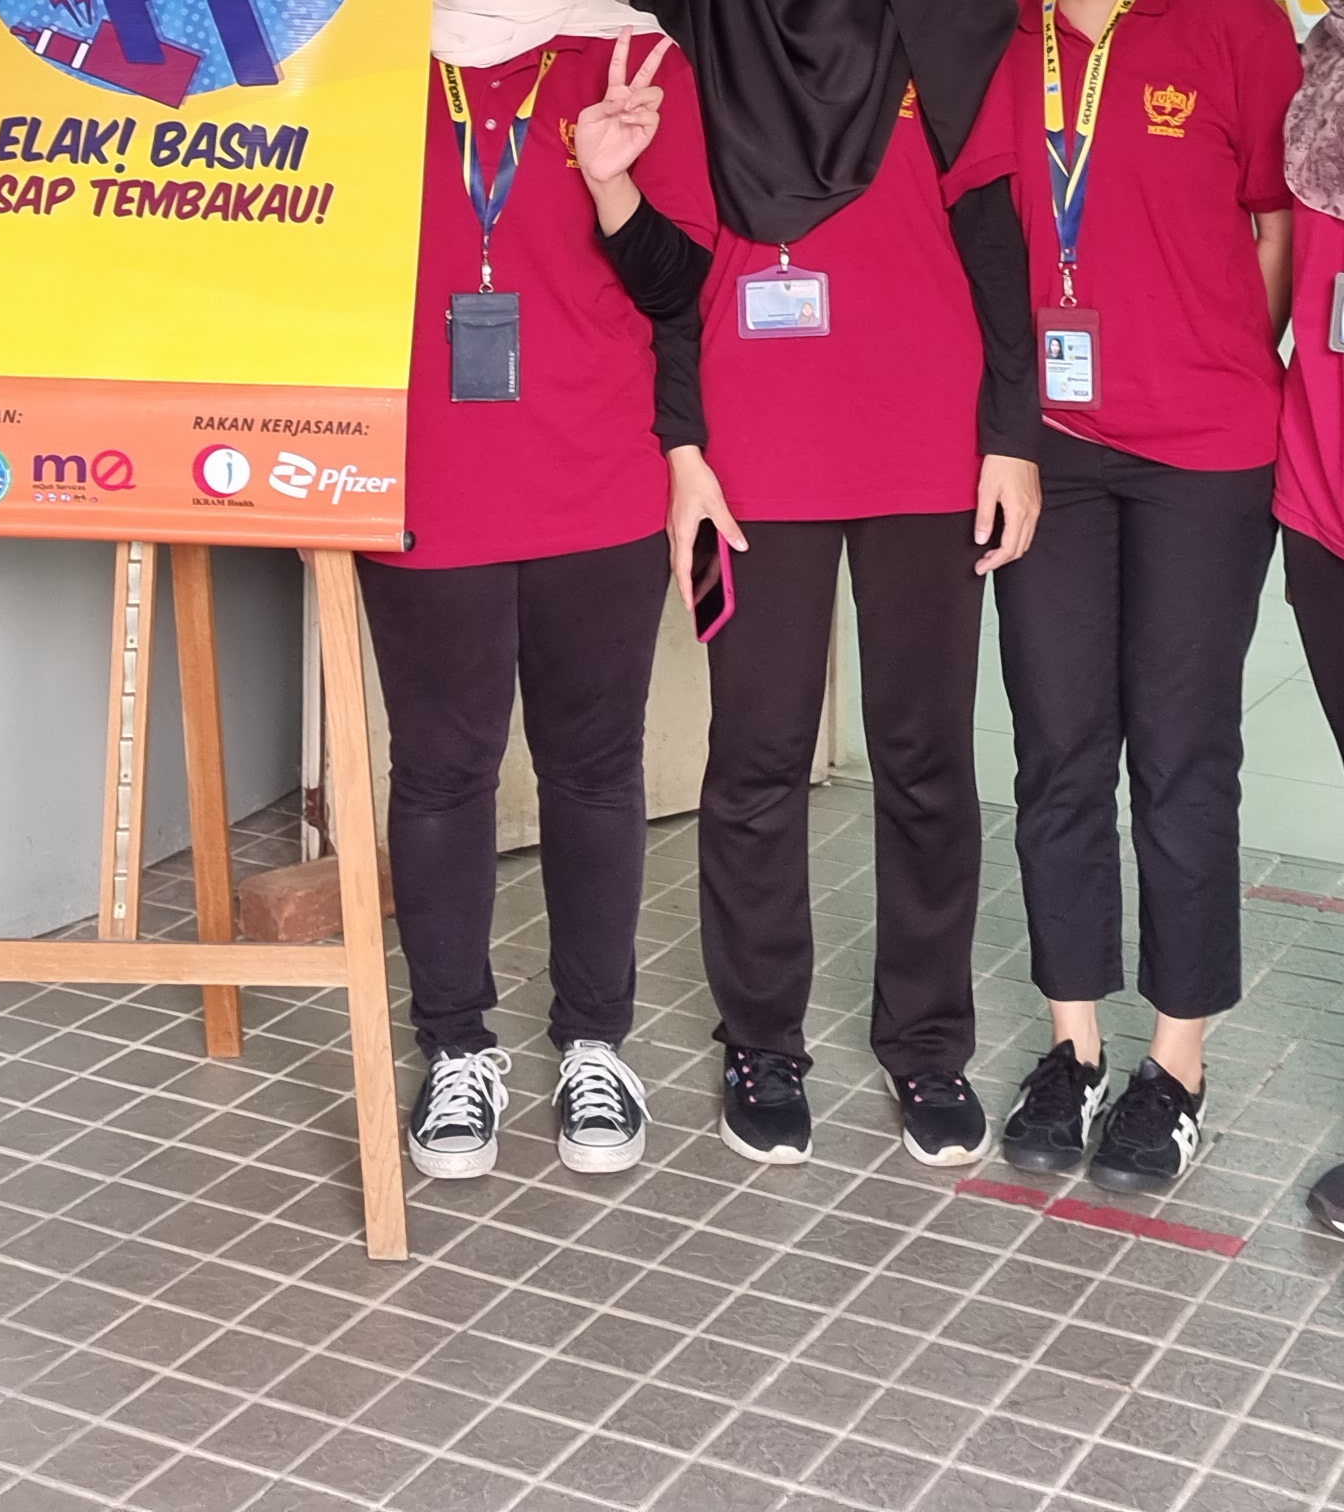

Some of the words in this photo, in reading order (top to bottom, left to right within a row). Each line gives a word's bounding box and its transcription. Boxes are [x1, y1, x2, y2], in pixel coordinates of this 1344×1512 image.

[1082, 51, 1104, 126] GENERATIONAL
[150, 120, 309, 171] BASMI
[90, 178, 334, 225] TEMBAKAU!
[192, 416, 256, 432] RAKAN
[260, 418, 370, 437] KERJASAMA:
[317, 464, 397, 505] Pfizer
